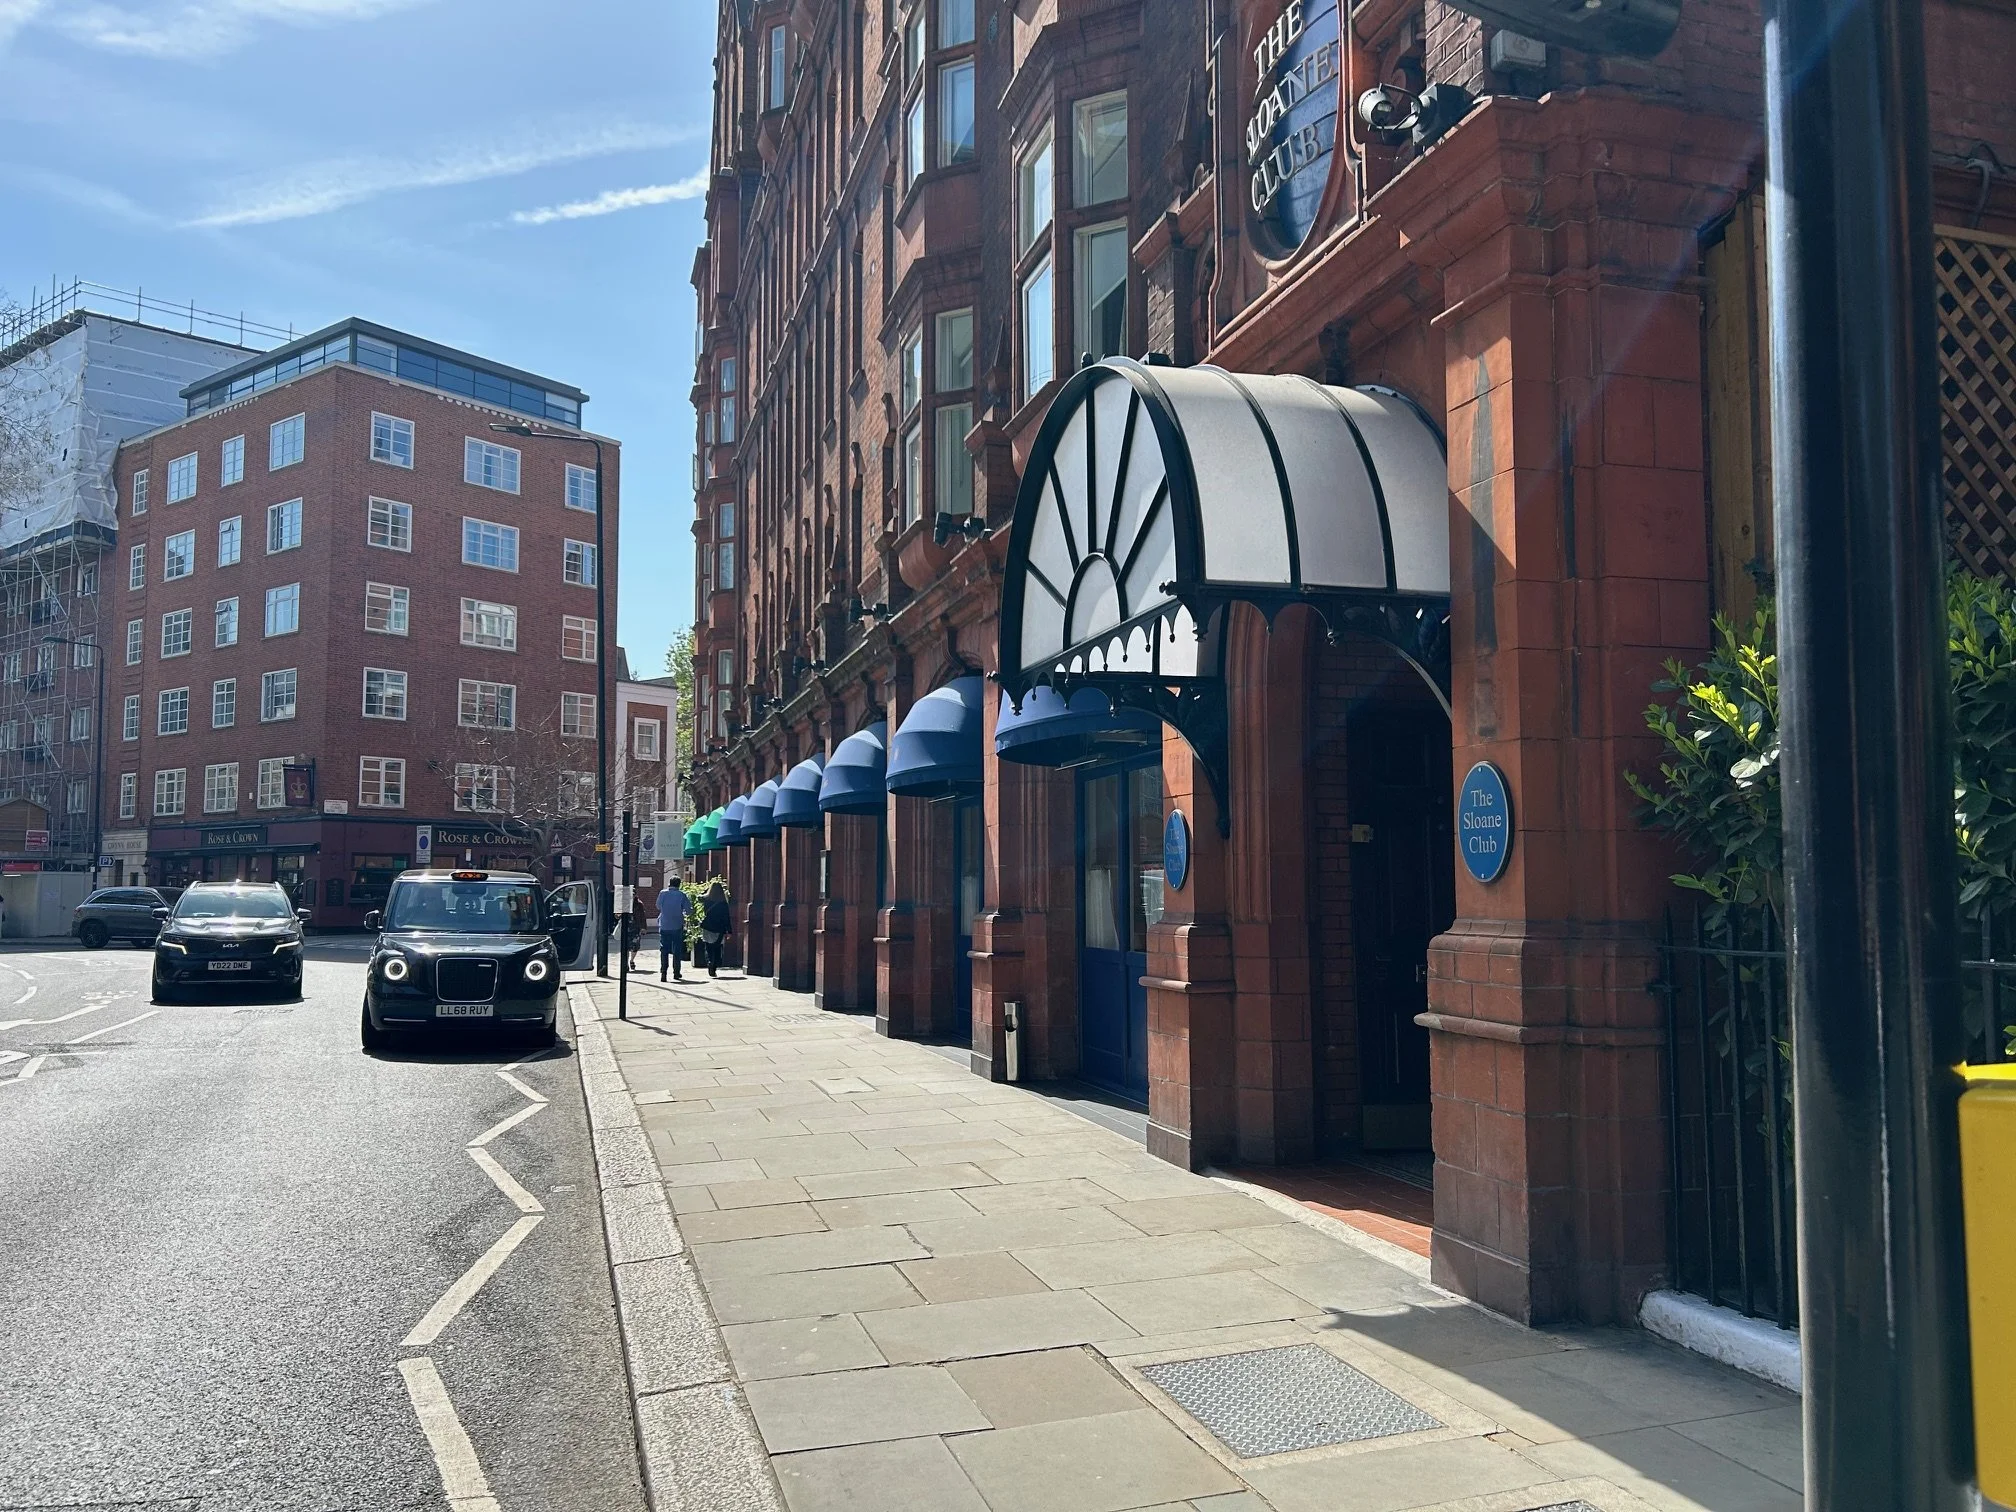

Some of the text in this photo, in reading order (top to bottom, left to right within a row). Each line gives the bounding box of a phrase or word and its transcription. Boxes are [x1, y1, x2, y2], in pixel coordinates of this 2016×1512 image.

[1253, 0, 1304, 83] THE
[1251, 122, 1322, 213] CLUB
[1471, 789, 1493, 807] The
[1463, 812, 1502, 830] Sloane
[437, 830, 469, 844] ROSE
[471, 834, 481, 845] &
[1469, 836, 1497, 854] Club
[440, 1005, 489, 1015] LL68 RUY
